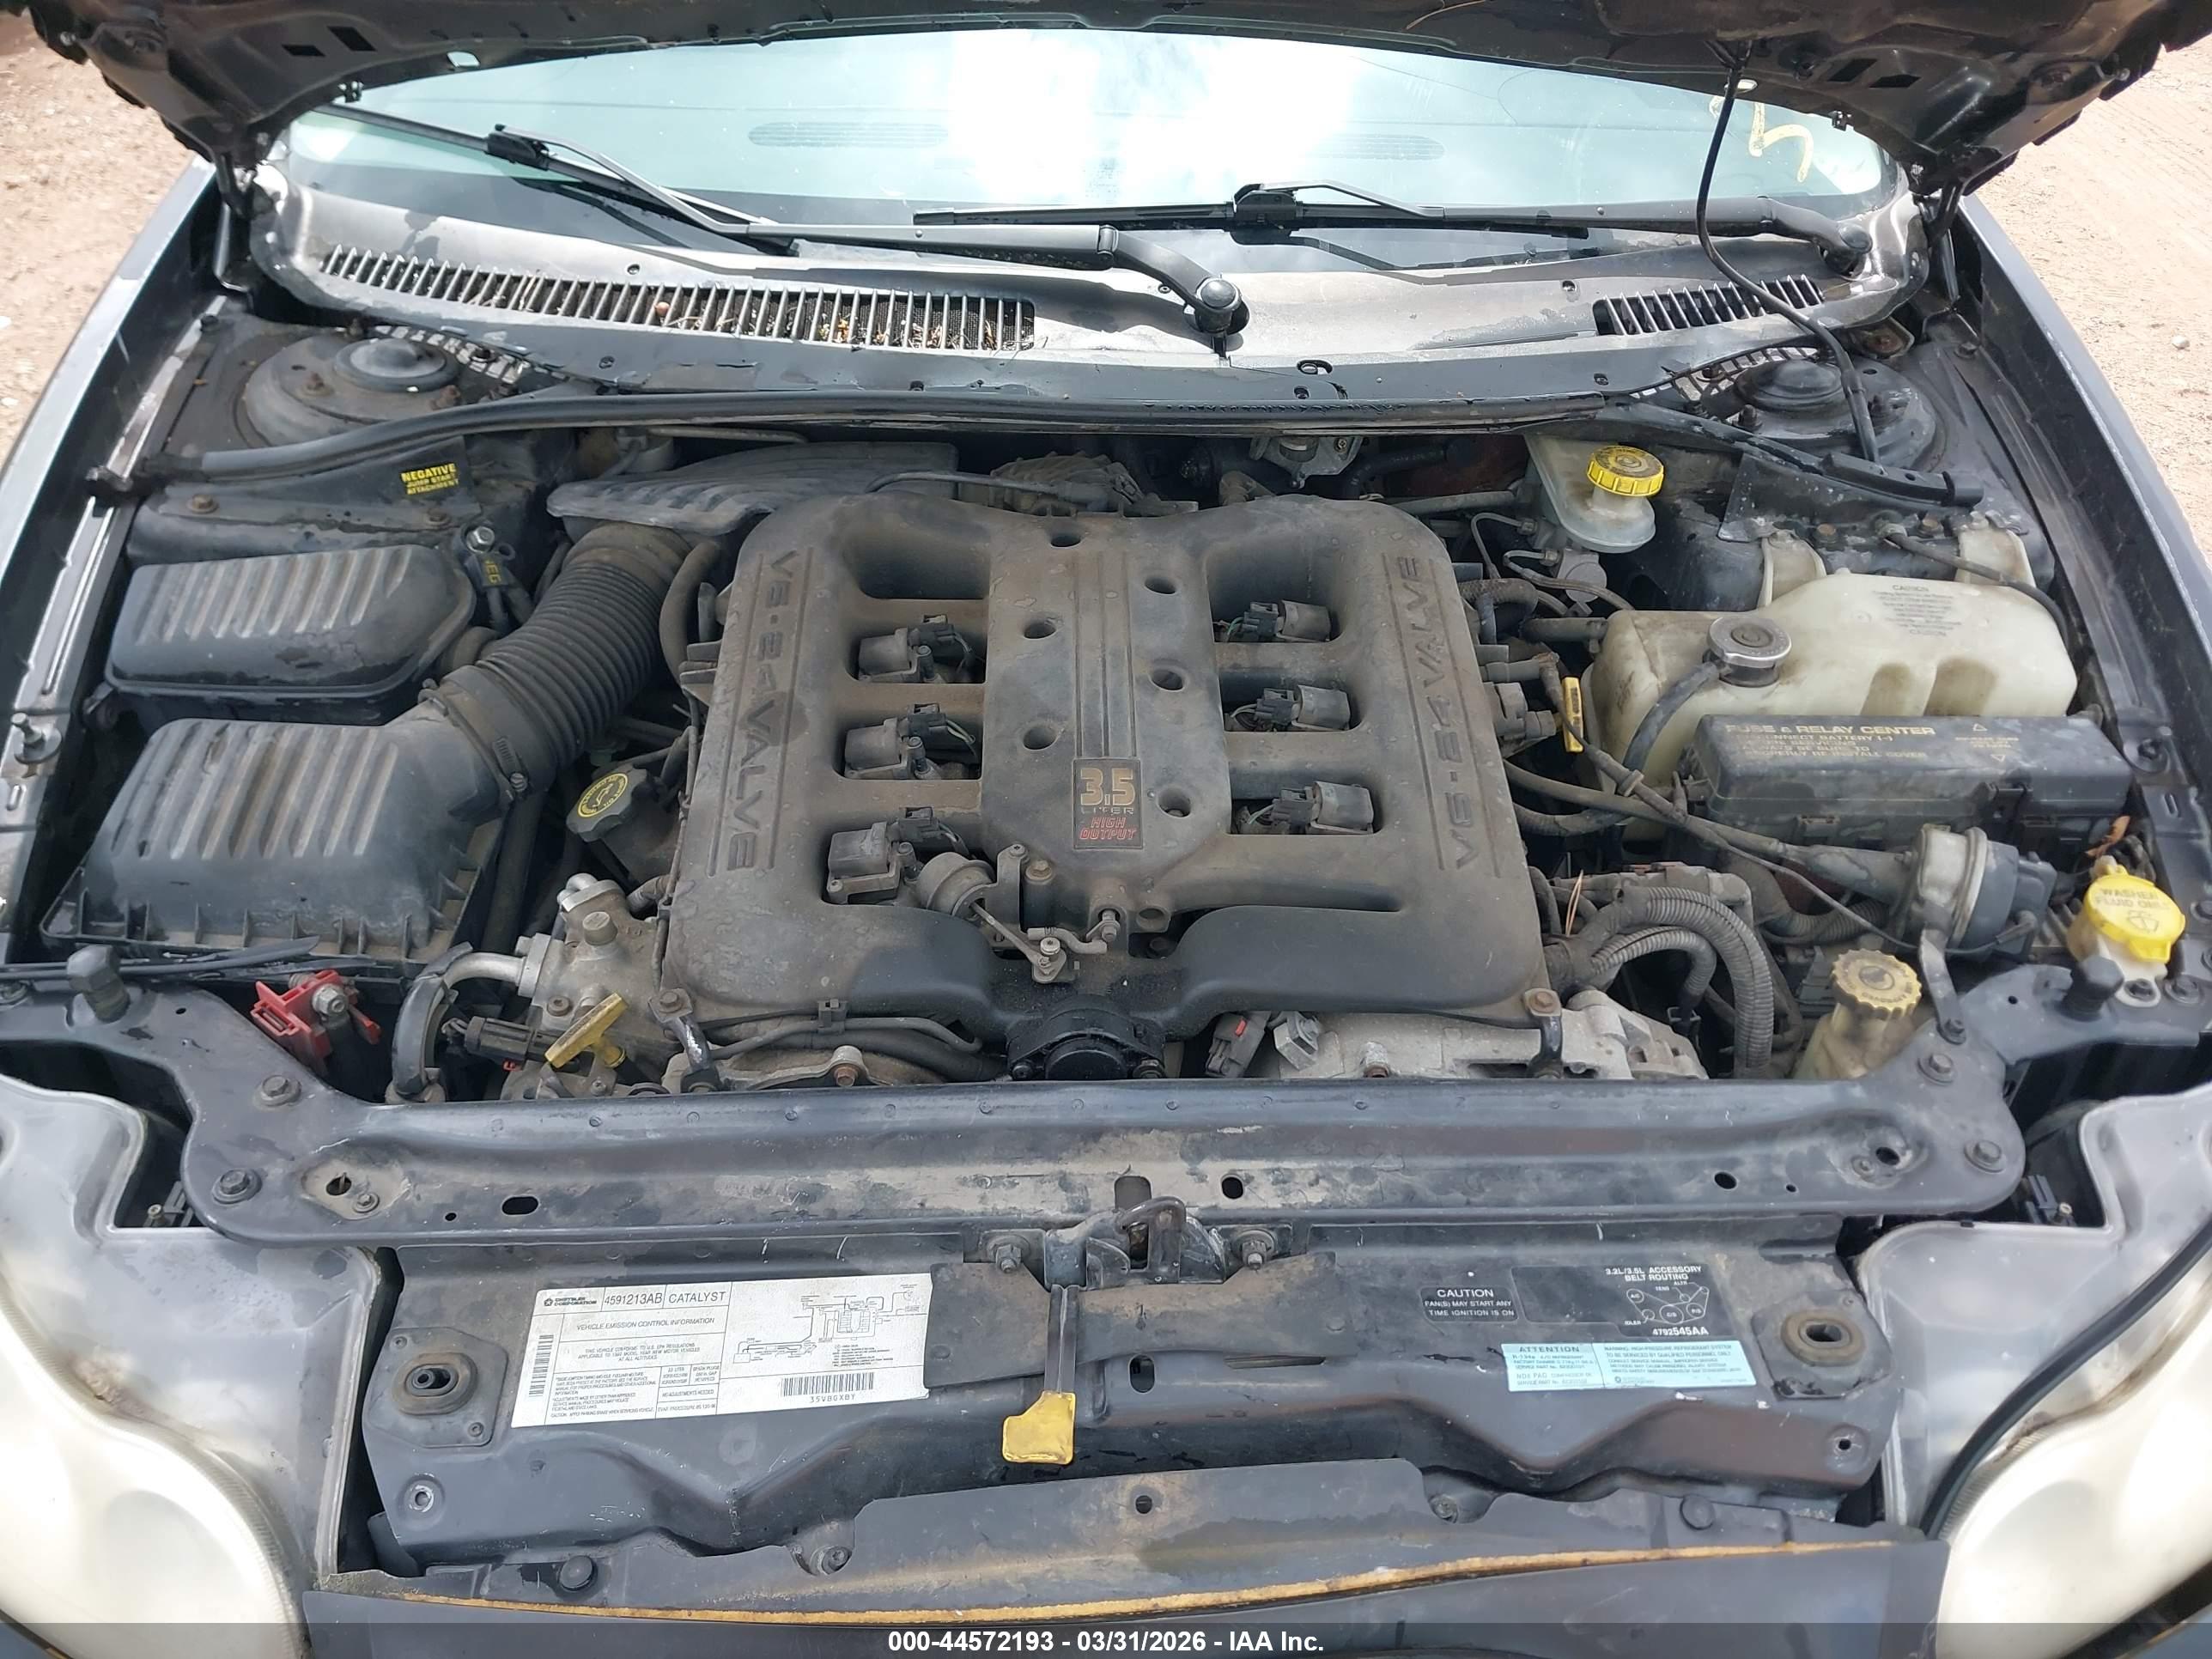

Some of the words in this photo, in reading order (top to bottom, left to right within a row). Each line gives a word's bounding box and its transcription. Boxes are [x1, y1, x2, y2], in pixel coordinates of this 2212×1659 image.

[401, 463, 456, 483] NEGATIVE
[1397, 556, 1446, 688] VALVE
[1796, 726, 1854, 734] RELAY
[1860, 726, 1936, 735] CENTER
[727, 700, 775, 871] VALVE
[1080, 768, 1136, 806] 3.5
[1091, 817, 1126, 829] HIGH
[1079, 830, 1137, 840] OUTPUT
[2100, 889, 2159, 900] WASHER
[1649, 1266, 1702, 1274] ACCESSORY
[1649, 1273, 1689, 1281] ROUTING
[605, 1292, 662, 1305] 4591213AB
[668, 1291, 726, 1304] CATALYST
[1437, 1289, 1494, 1297] CAUTION
[605, 1321, 636, 1329] EMISSION
[638, 1319, 668, 1328] CONTROL
[670, 1317, 715, 1326] INFORMATION
[1652, 1327, 1710, 1336] 4792545AA
